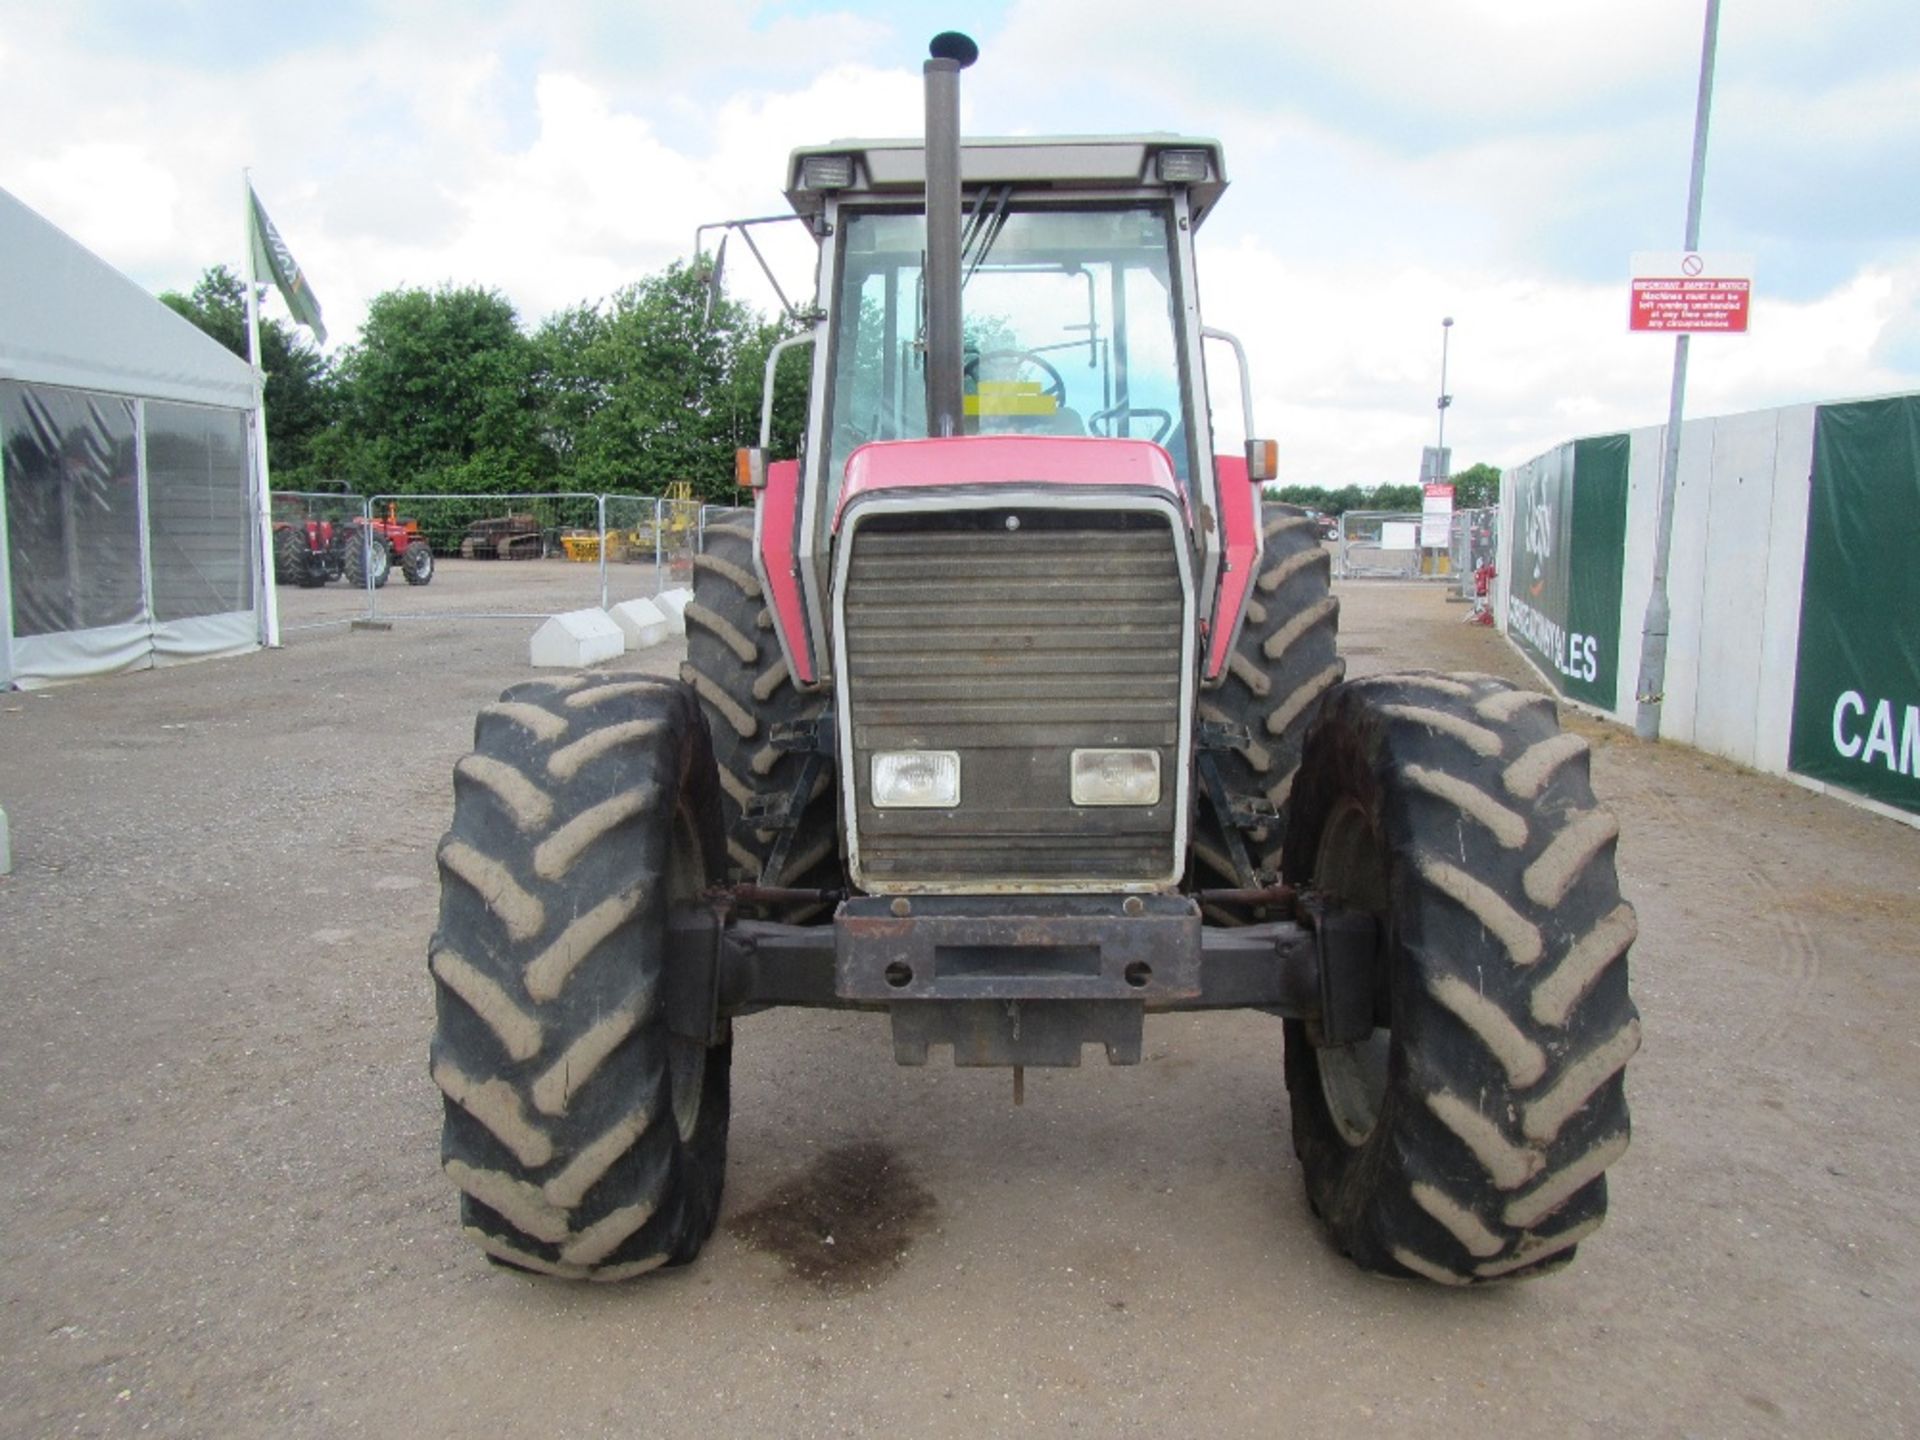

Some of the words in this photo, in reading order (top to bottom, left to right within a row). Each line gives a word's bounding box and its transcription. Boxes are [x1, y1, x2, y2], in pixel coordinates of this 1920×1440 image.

[1641, 292, 1683, 300] Machines
[1685, 292, 1708, 300] must
[1710, 292, 1725, 300] not
[1727, 292, 1739, 300] be
[1639, 301, 1654, 309] left
[1656, 302, 1689, 311] running
[1691, 302, 1740, 310] unattended
[1648, 321, 1664, 329] any
